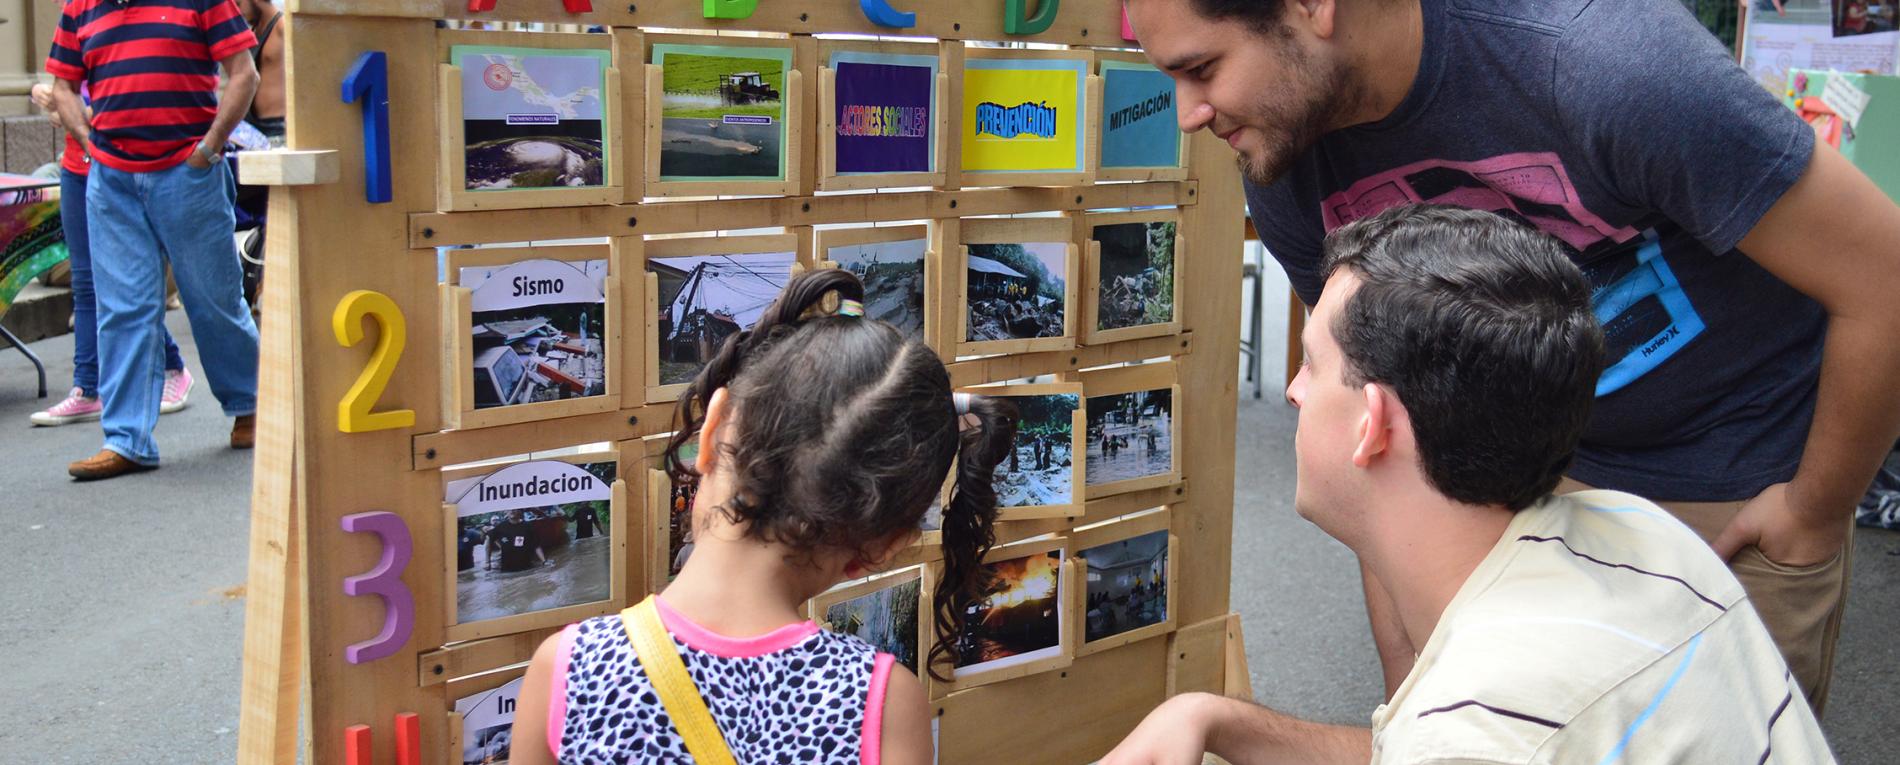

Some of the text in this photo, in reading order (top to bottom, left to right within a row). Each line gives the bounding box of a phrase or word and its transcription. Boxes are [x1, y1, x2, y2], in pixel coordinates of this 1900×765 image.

[341, 51, 393, 204] 1
[838, 104, 927, 138] ACTORES SOCIALES
[975, 100, 1057, 139] PREVENCIÓN
[1109, 89, 1172, 132] MITIGACIÓN
[512, 275, 565, 297] Sismo
[332, 289, 416, 433] 2
[1641, 332, 1670, 358] Hurley
[479, 473, 593, 502] Inundacion
[341, 510, 416, 665] 3
